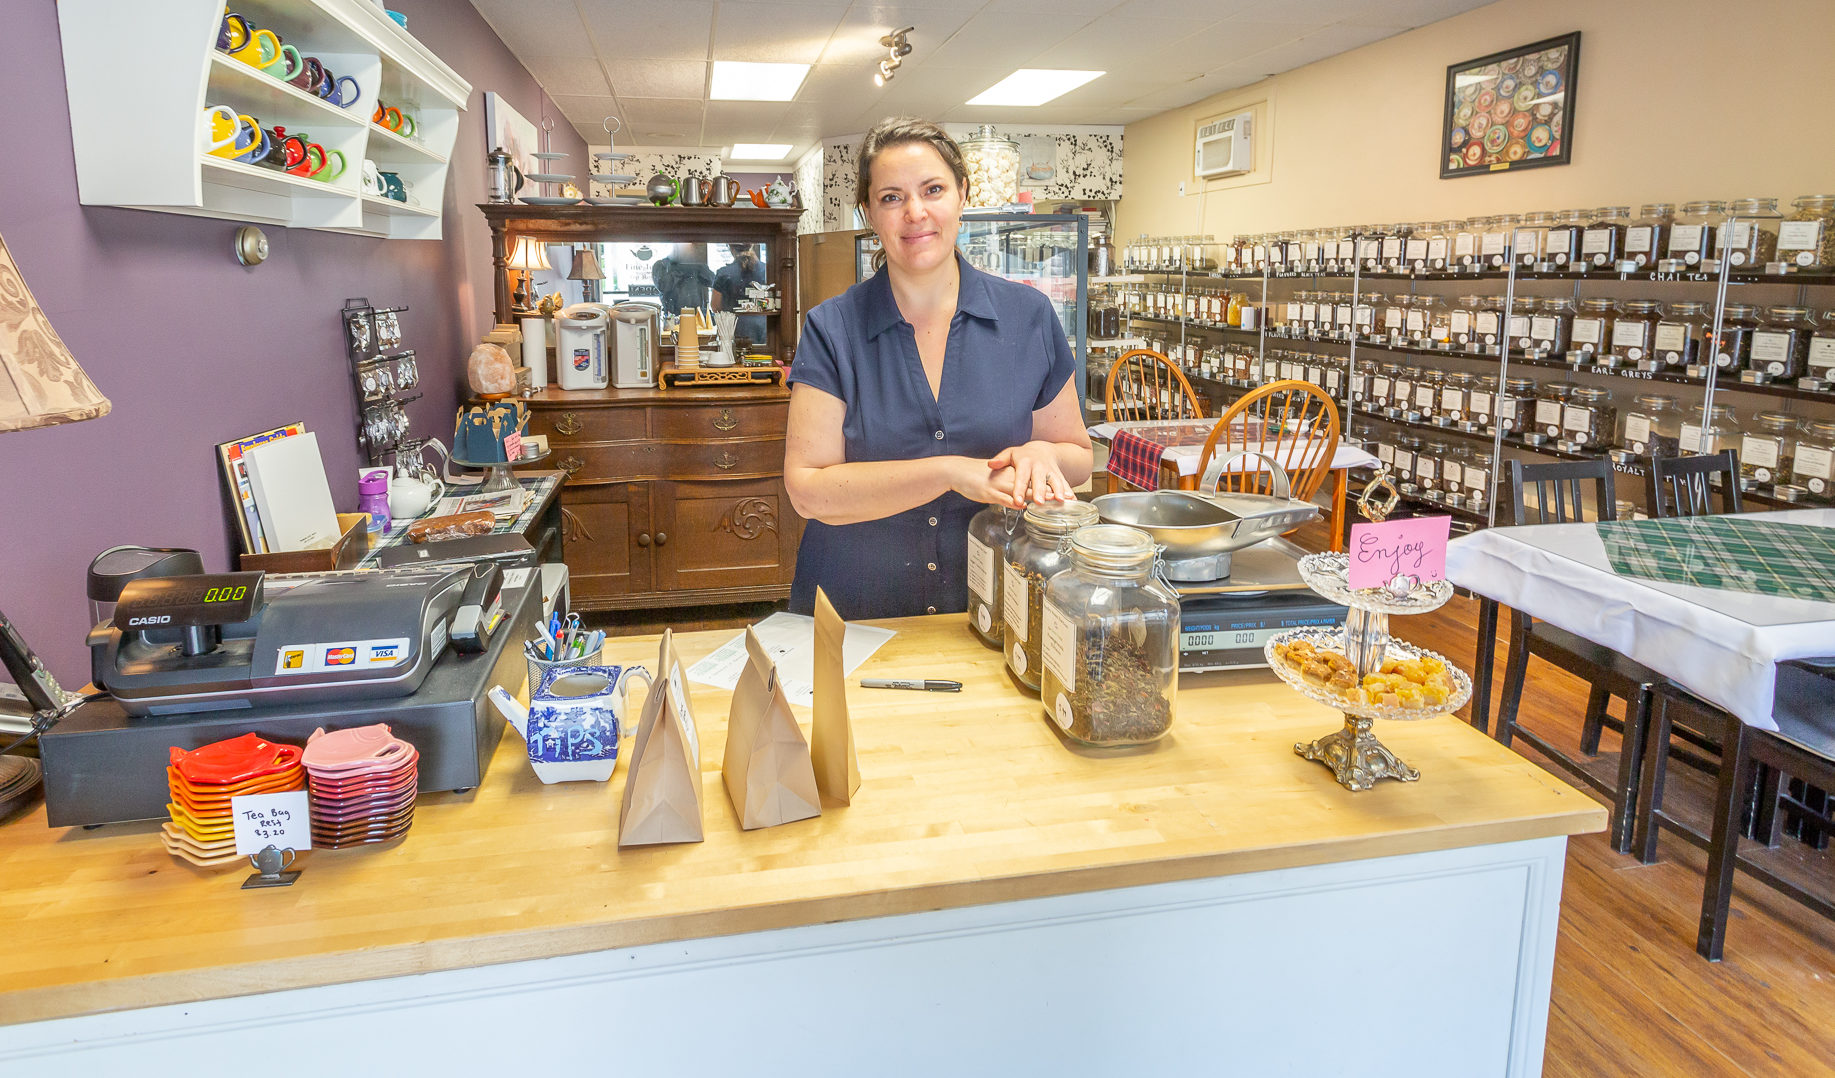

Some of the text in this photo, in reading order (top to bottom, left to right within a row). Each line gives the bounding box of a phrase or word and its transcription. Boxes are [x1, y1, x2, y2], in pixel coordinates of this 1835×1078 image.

[1649, 272, 1708, 281] CHAI TEA
[1591, 365, 1653, 380] EARL GREYS
[1358, 533, 1432, 575] Enjoy
[129, 615, 171, 626] CASIO
[375, 649, 394, 657] VISA
[242, 809, 290, 820] Tea Bag
